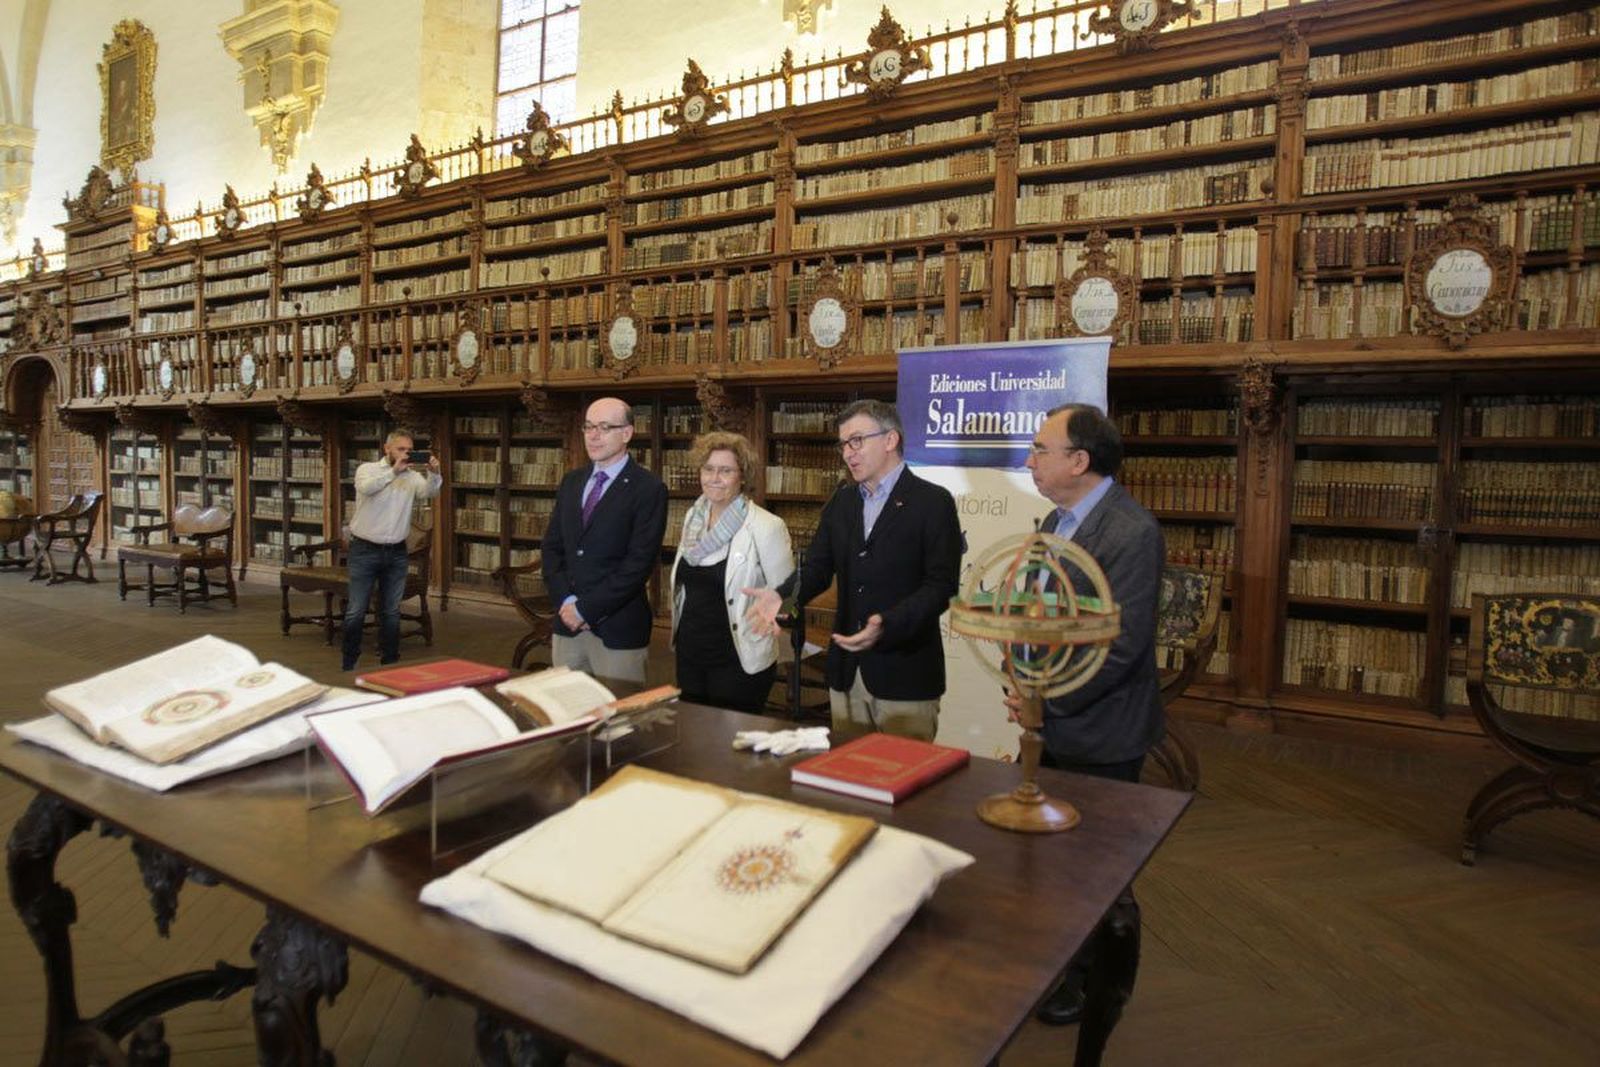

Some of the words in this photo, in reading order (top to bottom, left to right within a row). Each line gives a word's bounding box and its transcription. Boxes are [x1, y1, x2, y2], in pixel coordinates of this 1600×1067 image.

[930, 373, 987, 394] Ediciones
[990, 369, 1067, 392] Universidad
[926, 398, 1048, 435] Salamanc
